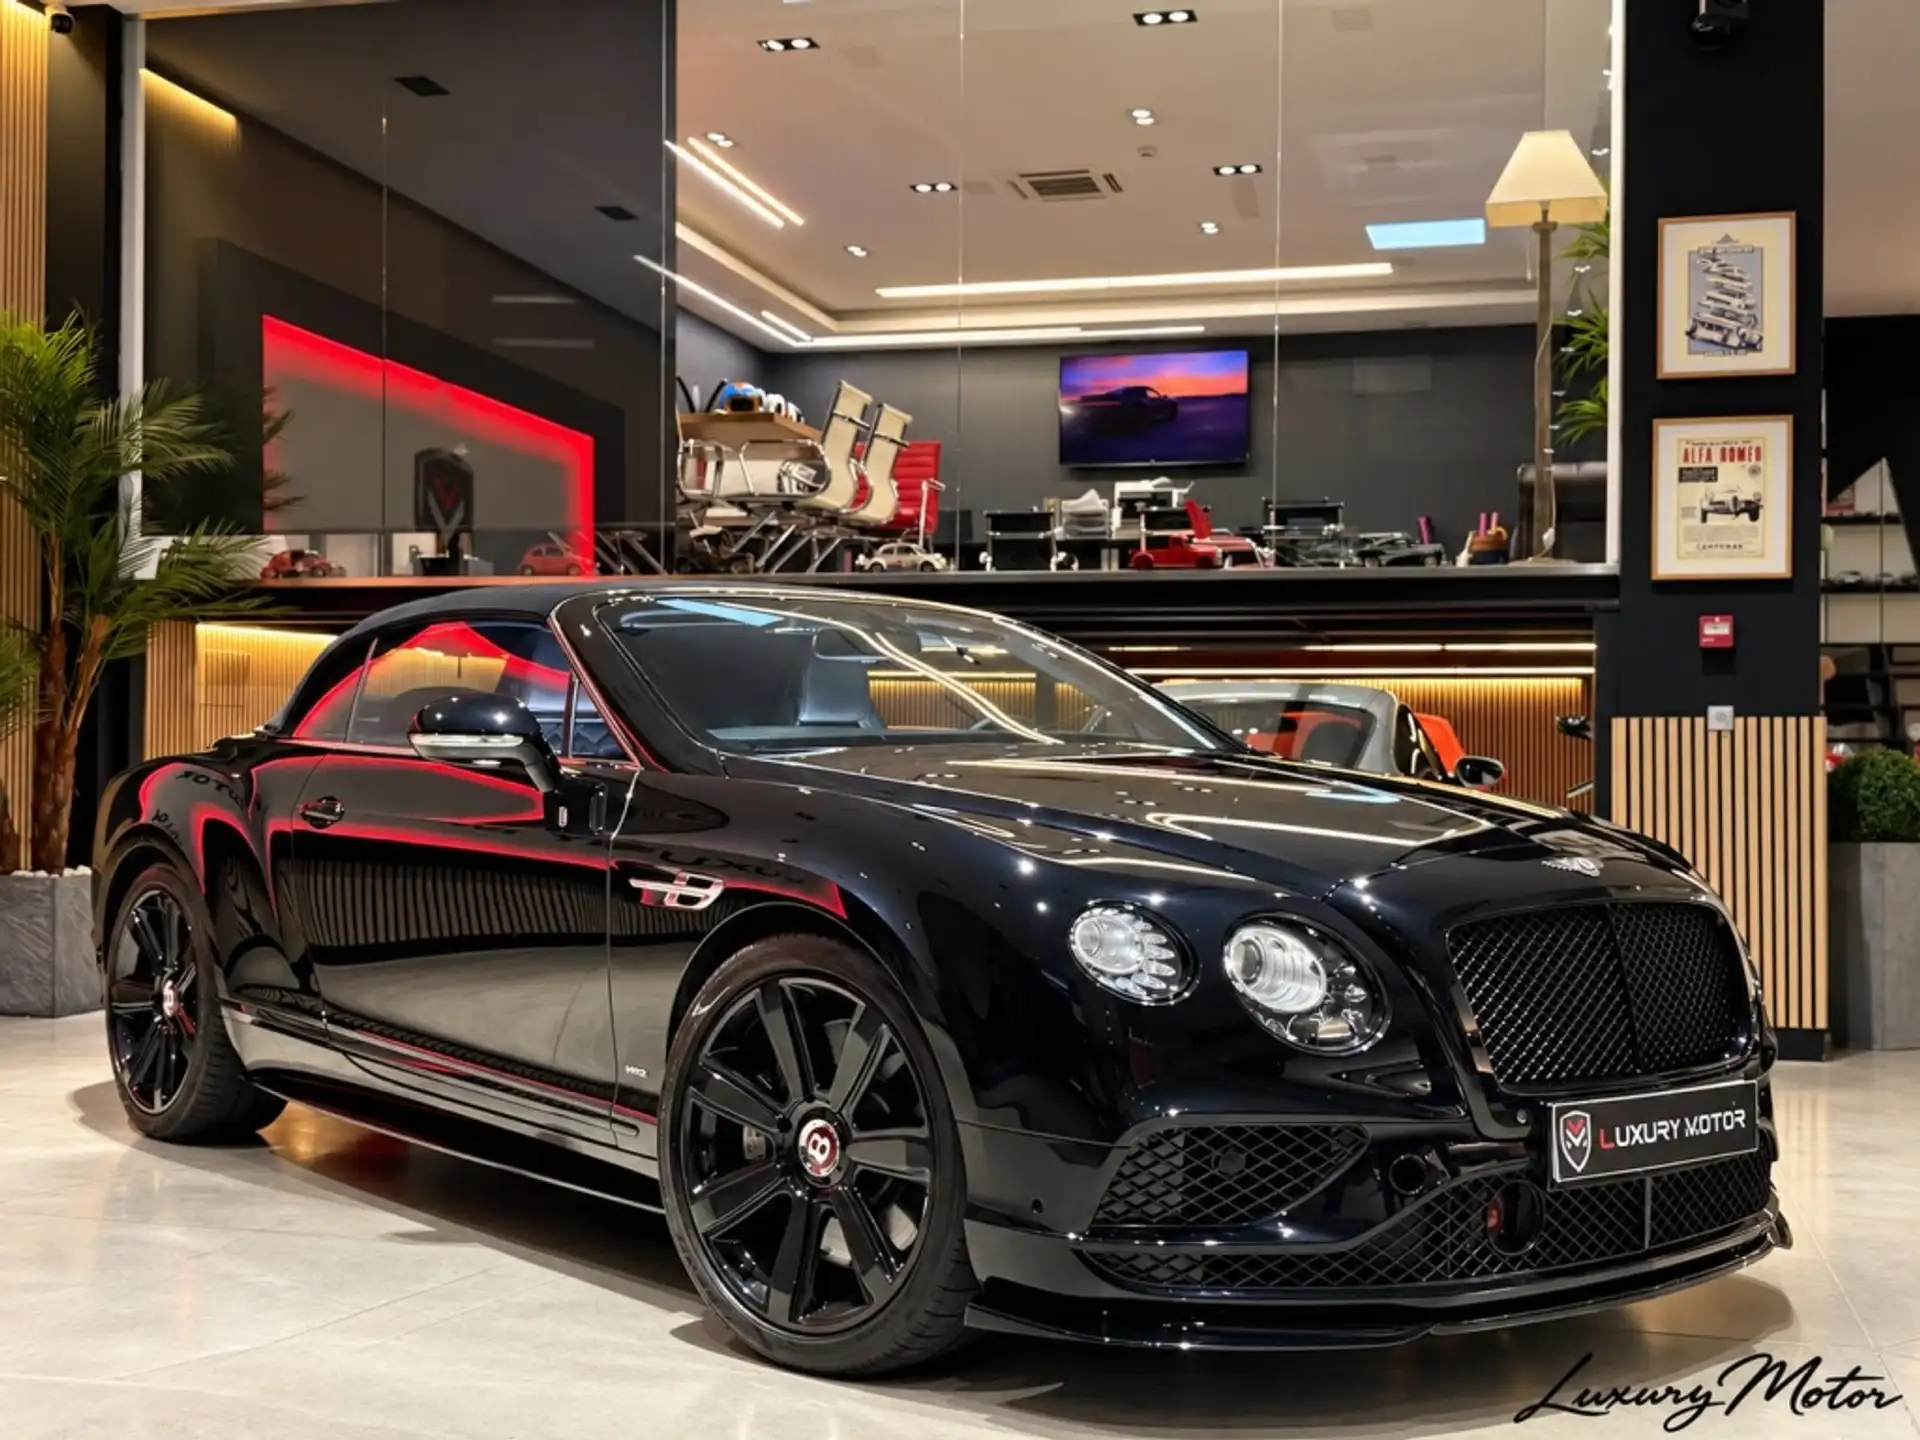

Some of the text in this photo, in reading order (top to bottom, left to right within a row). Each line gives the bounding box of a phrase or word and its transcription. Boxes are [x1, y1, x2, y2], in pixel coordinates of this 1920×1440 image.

[1682, 444, 1761, 464] ALFA ROMEO
[1599, 1109, 1746, 1149] LUXURY MOTOR
